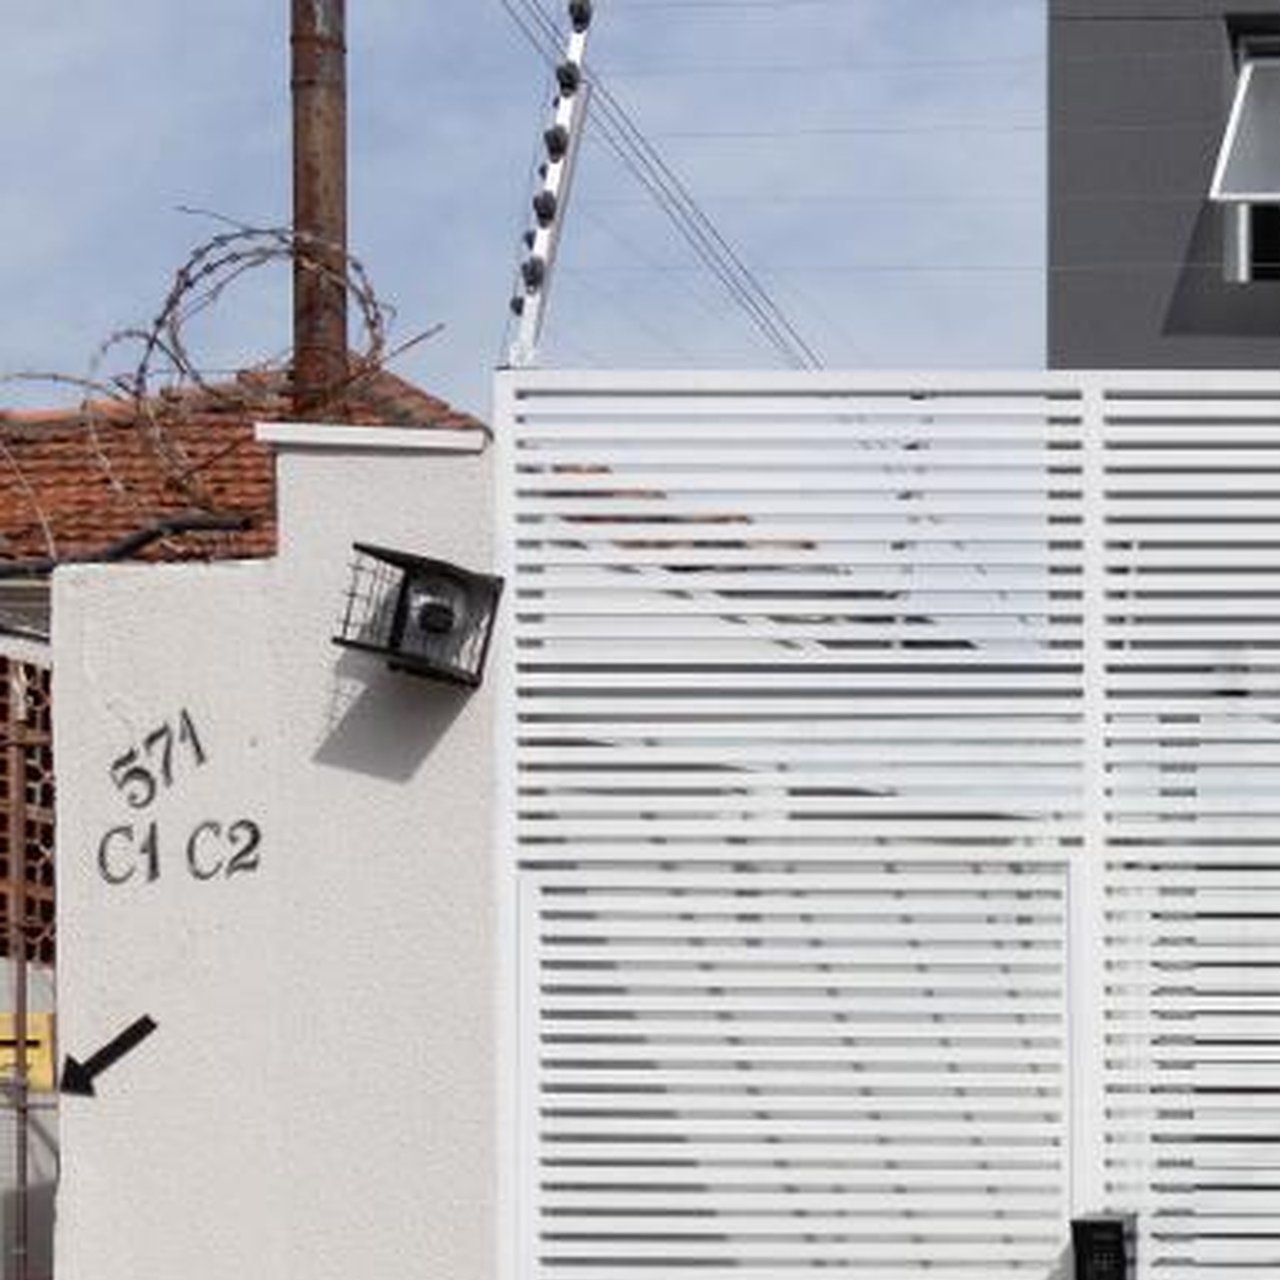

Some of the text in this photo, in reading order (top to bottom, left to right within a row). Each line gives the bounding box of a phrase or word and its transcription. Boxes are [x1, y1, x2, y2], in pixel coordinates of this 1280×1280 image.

[110, 708, 206, 809] 571
[97, 818, 262, 885] C1 C2
